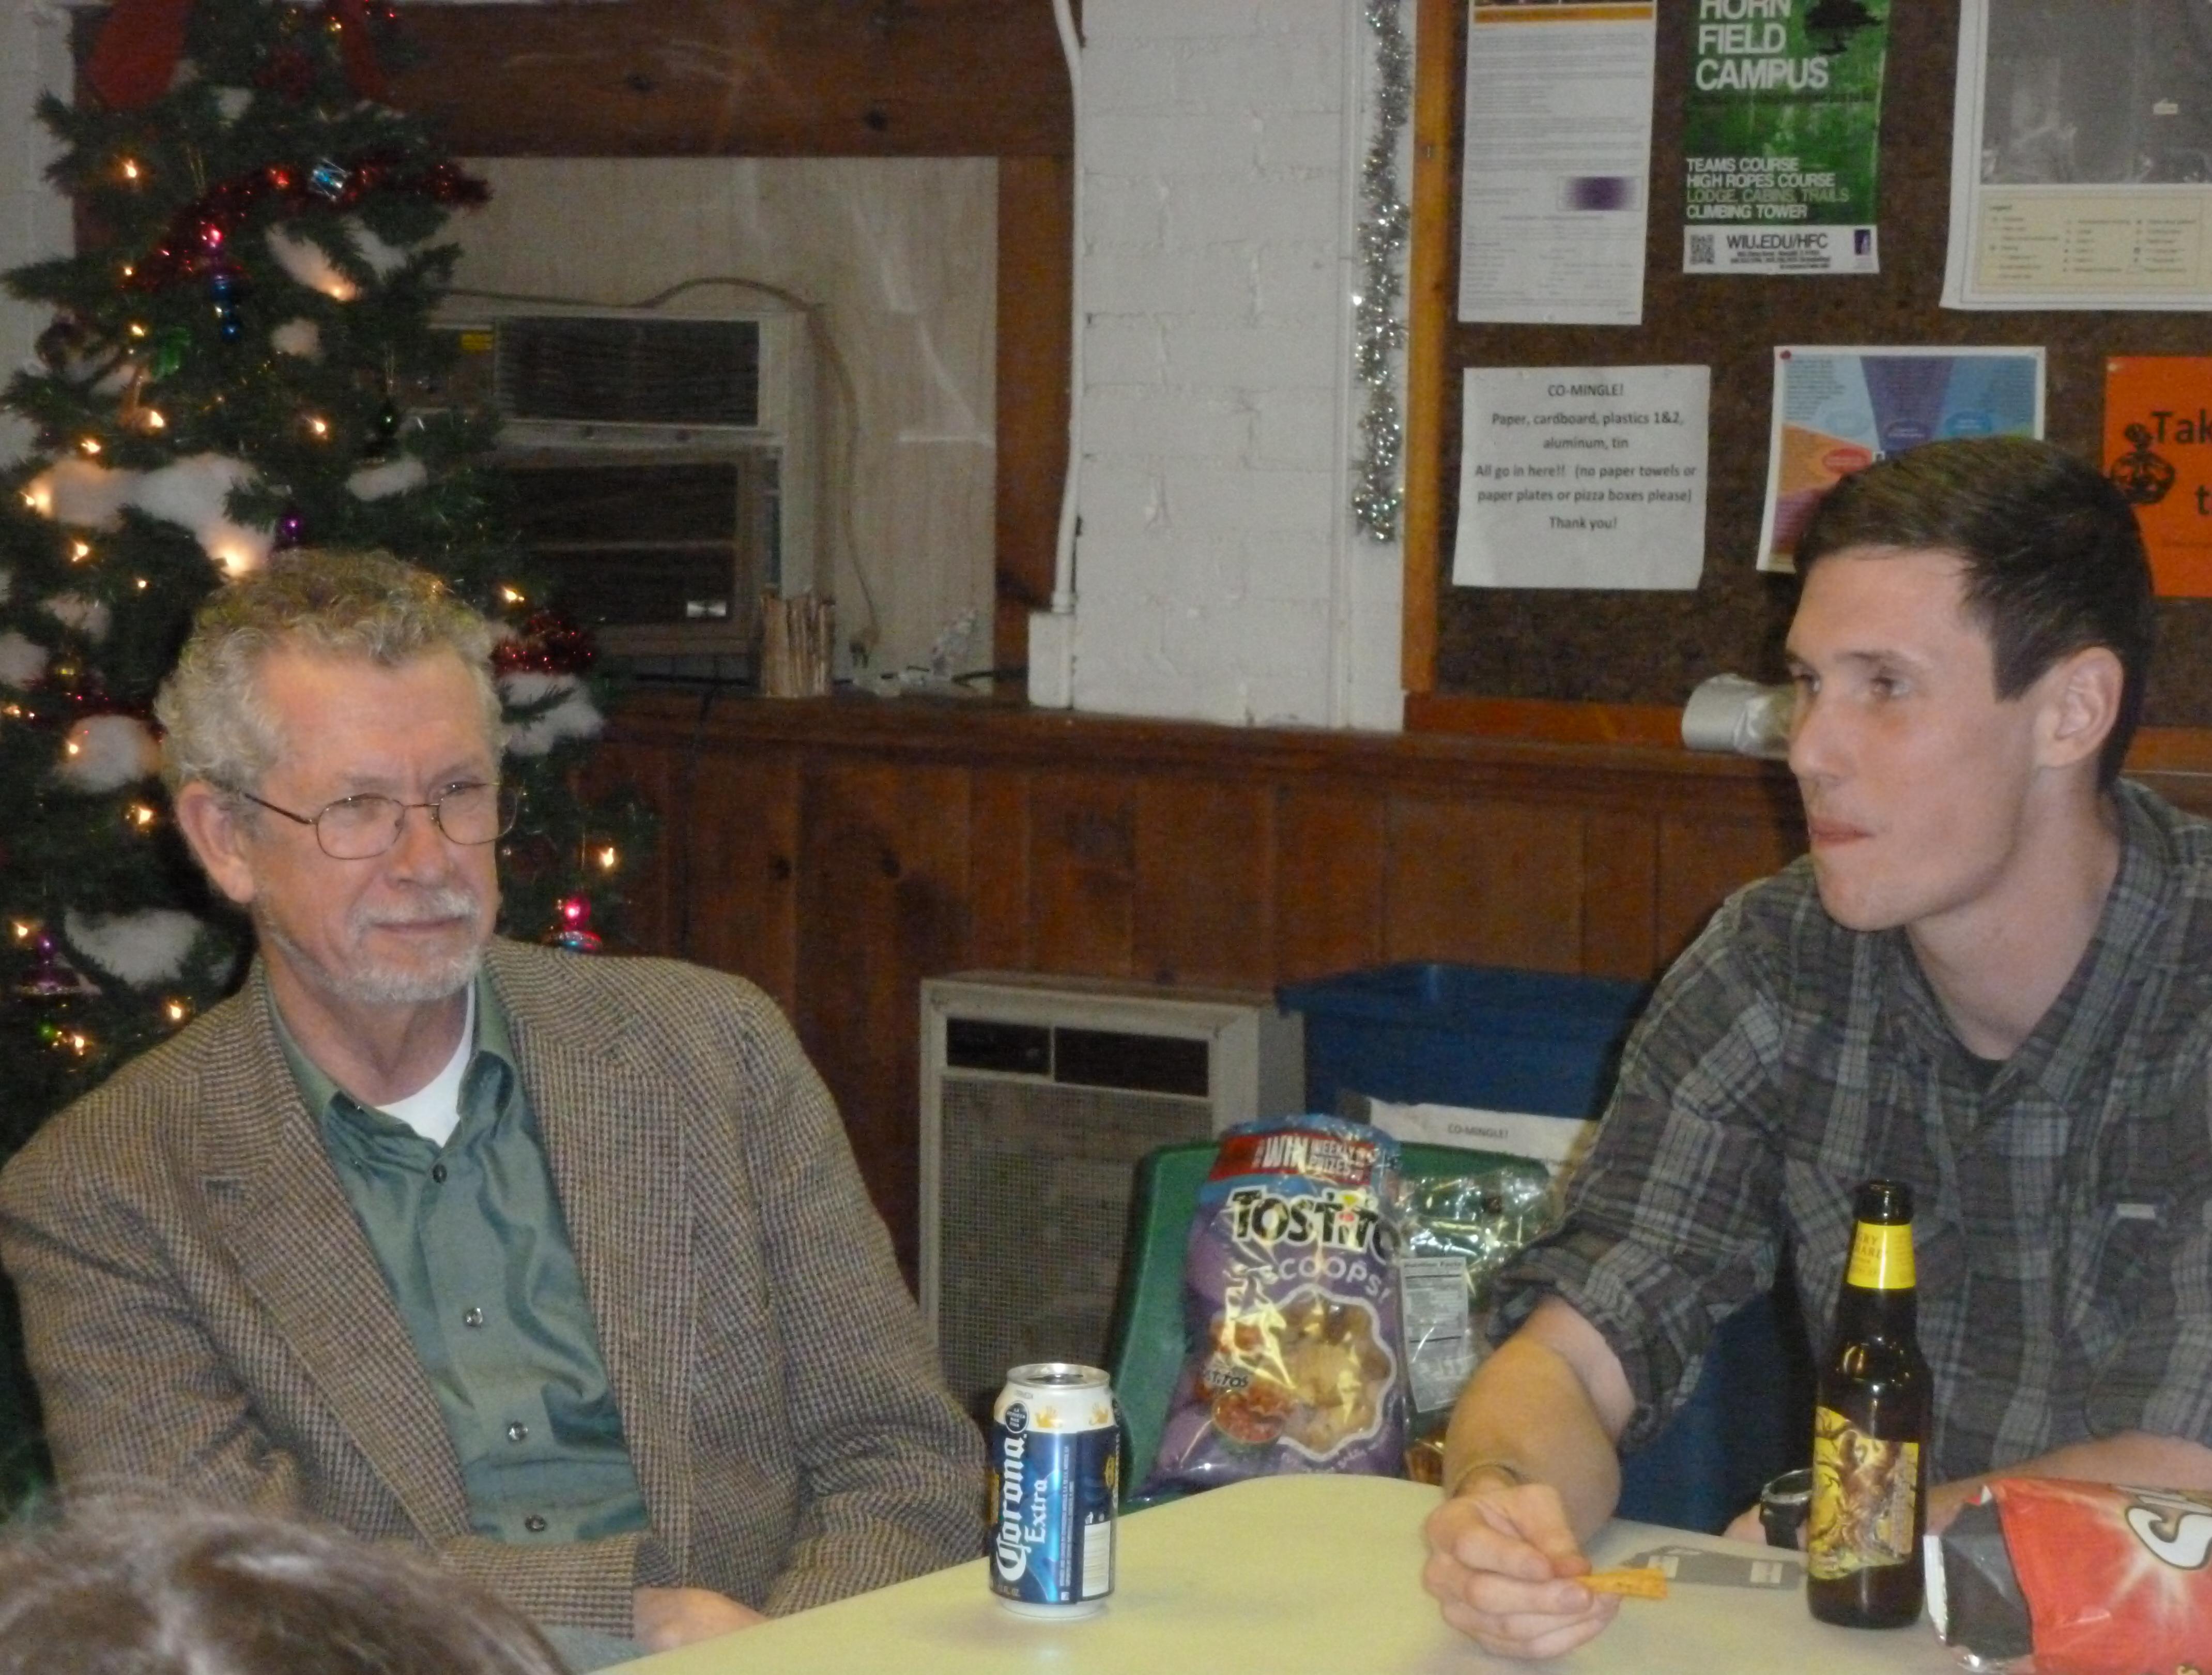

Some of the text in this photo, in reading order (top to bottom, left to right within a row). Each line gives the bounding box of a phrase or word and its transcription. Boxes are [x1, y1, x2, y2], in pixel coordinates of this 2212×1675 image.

[1699, 0, 1792, 20] HORN
[1698, 23, 1787, 55] FIELD
[1696, 56, 1829, 91] CAMPUS
[1686, 157, 1800, 172] TEAMS COURSE
[1687, 172, 1836, 189] HIGH ROPES COURSE
[1803, 187, 1849, 202] TRAILS
[1686, 204, 1807, 219] CLIMBING TOWER
[1726, 233, 1829, 249] WIU.EDU/HFC
[1547, 383, 1624, 397] CO-MINGLE!
[1492, 413, 1530, 427] Paper,
[1533, 412, 1599, 426] cardboard,
[1603, 411, 1649, 428] plastics
[1543, 437, 1629, 451] aluminum, tin
[1476, 464, 1697, 481] All go in here!! (no paper towels or
[1477, 488, 1693, 504] paper plates or pizza boxes please)
[1549, 516, 1618, 532] Thank you!
[1448, 1123, 1510, 1139] CO-MINGLE!
[1262, 1135, 1311, 1170] WIN
[996, 1436, 1032, 1581] Corona
[1024, 1479, 1048, 1544] Extra
